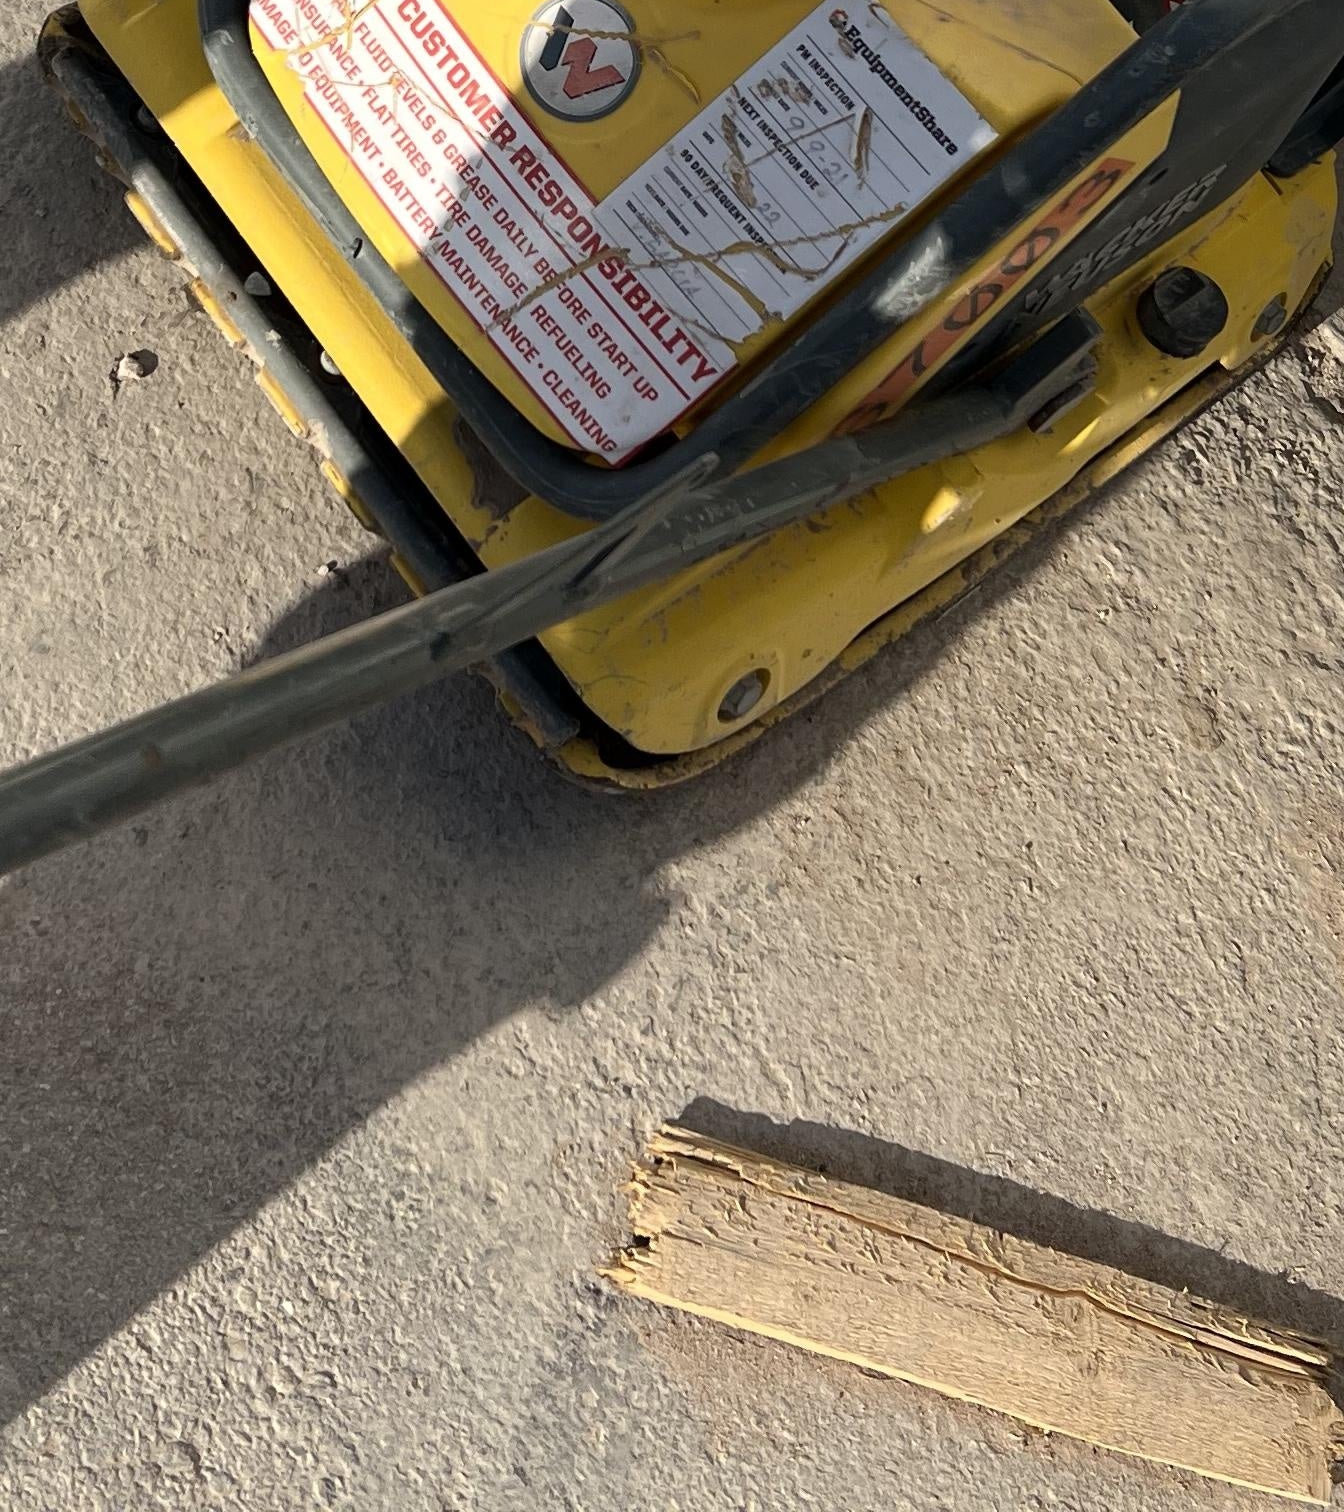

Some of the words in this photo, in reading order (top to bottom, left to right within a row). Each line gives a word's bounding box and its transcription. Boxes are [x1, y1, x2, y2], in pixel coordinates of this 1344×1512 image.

[736, 96, 760, 122] NEXT
[755, 118, 803, 171] INSPECTION
[798, 168, 820, 191] DUE
[794, 43, 812, 61] PM
[807, 57, 856, 111] INSPECTION
[839, 24, 961, 159] EquipmentShare
[304, 64, 384, 161] EQUIPMENT
[379, 167, 444, 243] BATTERY
[436, 240, 540, 363] MAINTENANCE
[539, 367, 617, 456] CLEANING
[350, 21, 396, 74] FLUID
[430, 128, 449, 146] &
[440, 142, 499, 211] GREASE
[491, 206, 540, 261] DAILY
[585, 321, 638, 380] START
[630, 375, 660, 406] UP
[360, 86, 397, 127] FLAT
[388, 124, 435, 178] TIRES
[432, 183, 473, 228] TIRE
[464, 223, 529, 300] DAMAGE
[528, 303, 613, 400] REFUELING
[507, 143, 718, 388] RESPONSIBILITY
[678, 148, 695, 165] 90
[688, 160, 747, 226] DAY/FREQUENT
[741, 221, 790, 275] INSPON
